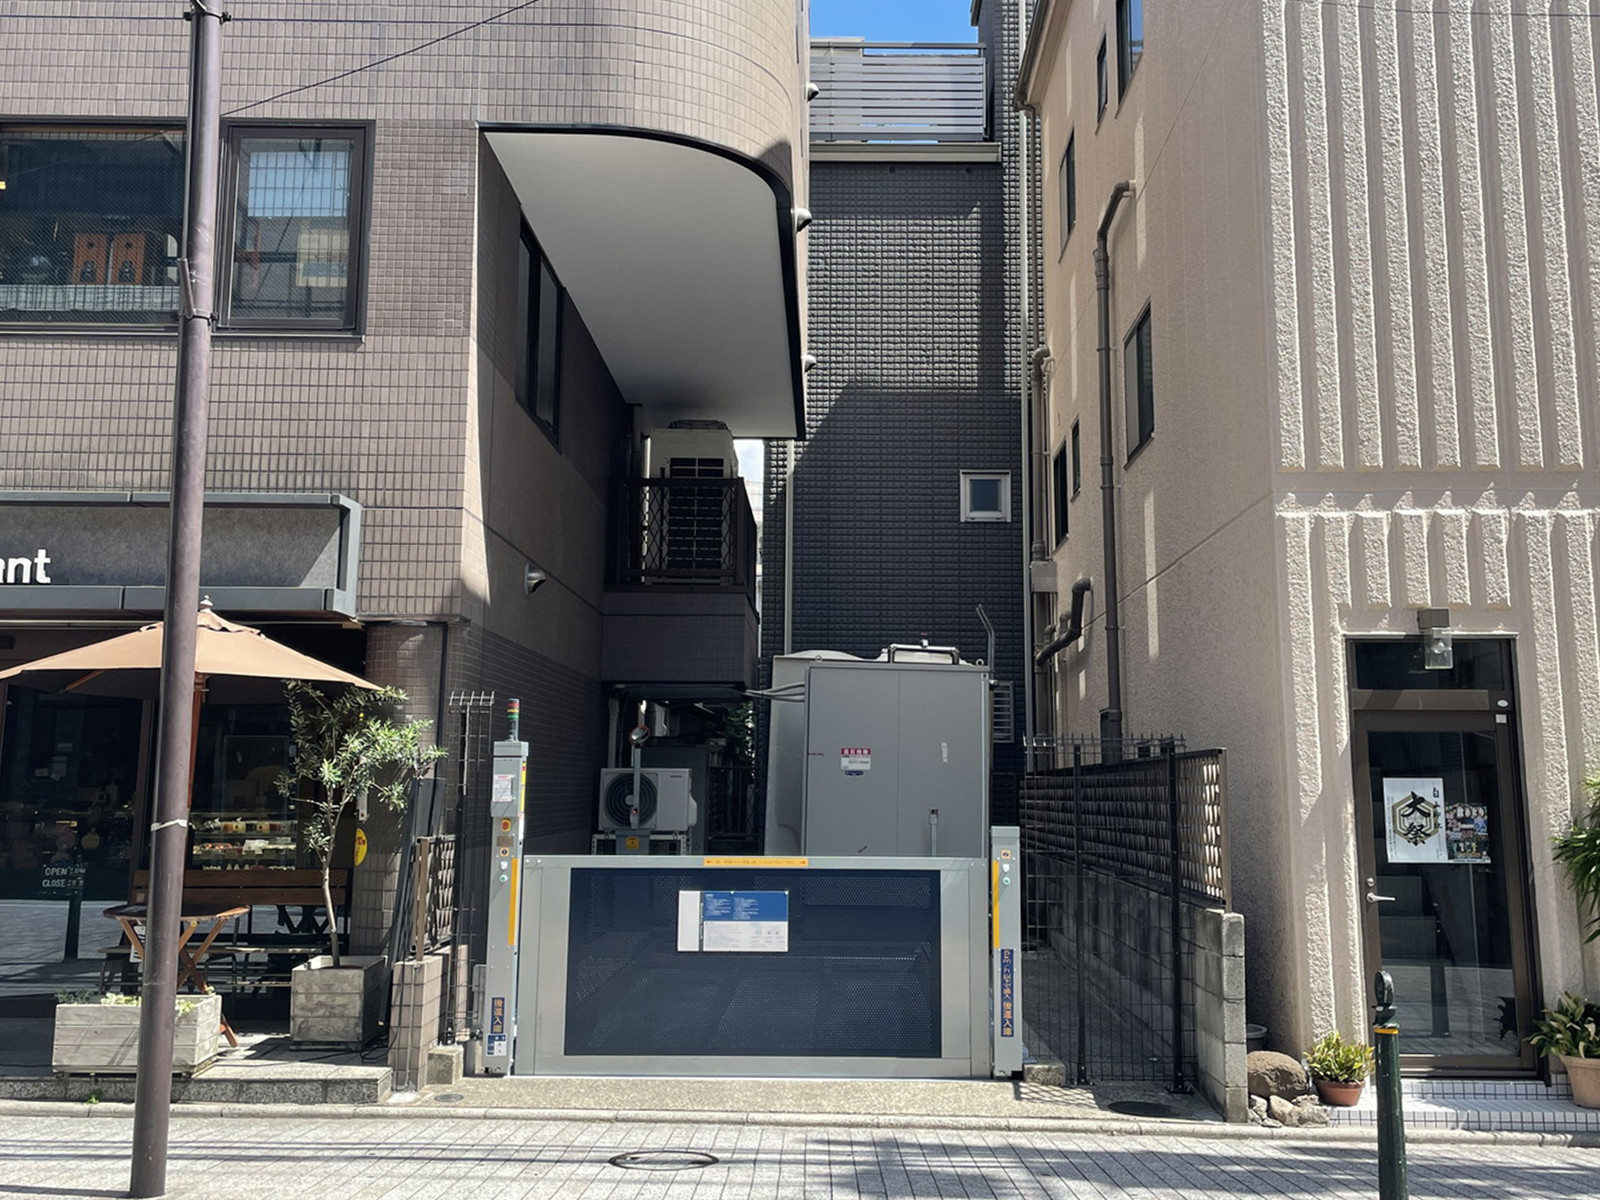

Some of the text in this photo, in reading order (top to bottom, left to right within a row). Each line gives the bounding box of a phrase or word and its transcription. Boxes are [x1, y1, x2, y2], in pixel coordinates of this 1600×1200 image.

[1400, 791, 1432, 847] 大祭
[44, 867, 68, 876] OPEN
[41, 879, 66, 888] CLOSE
